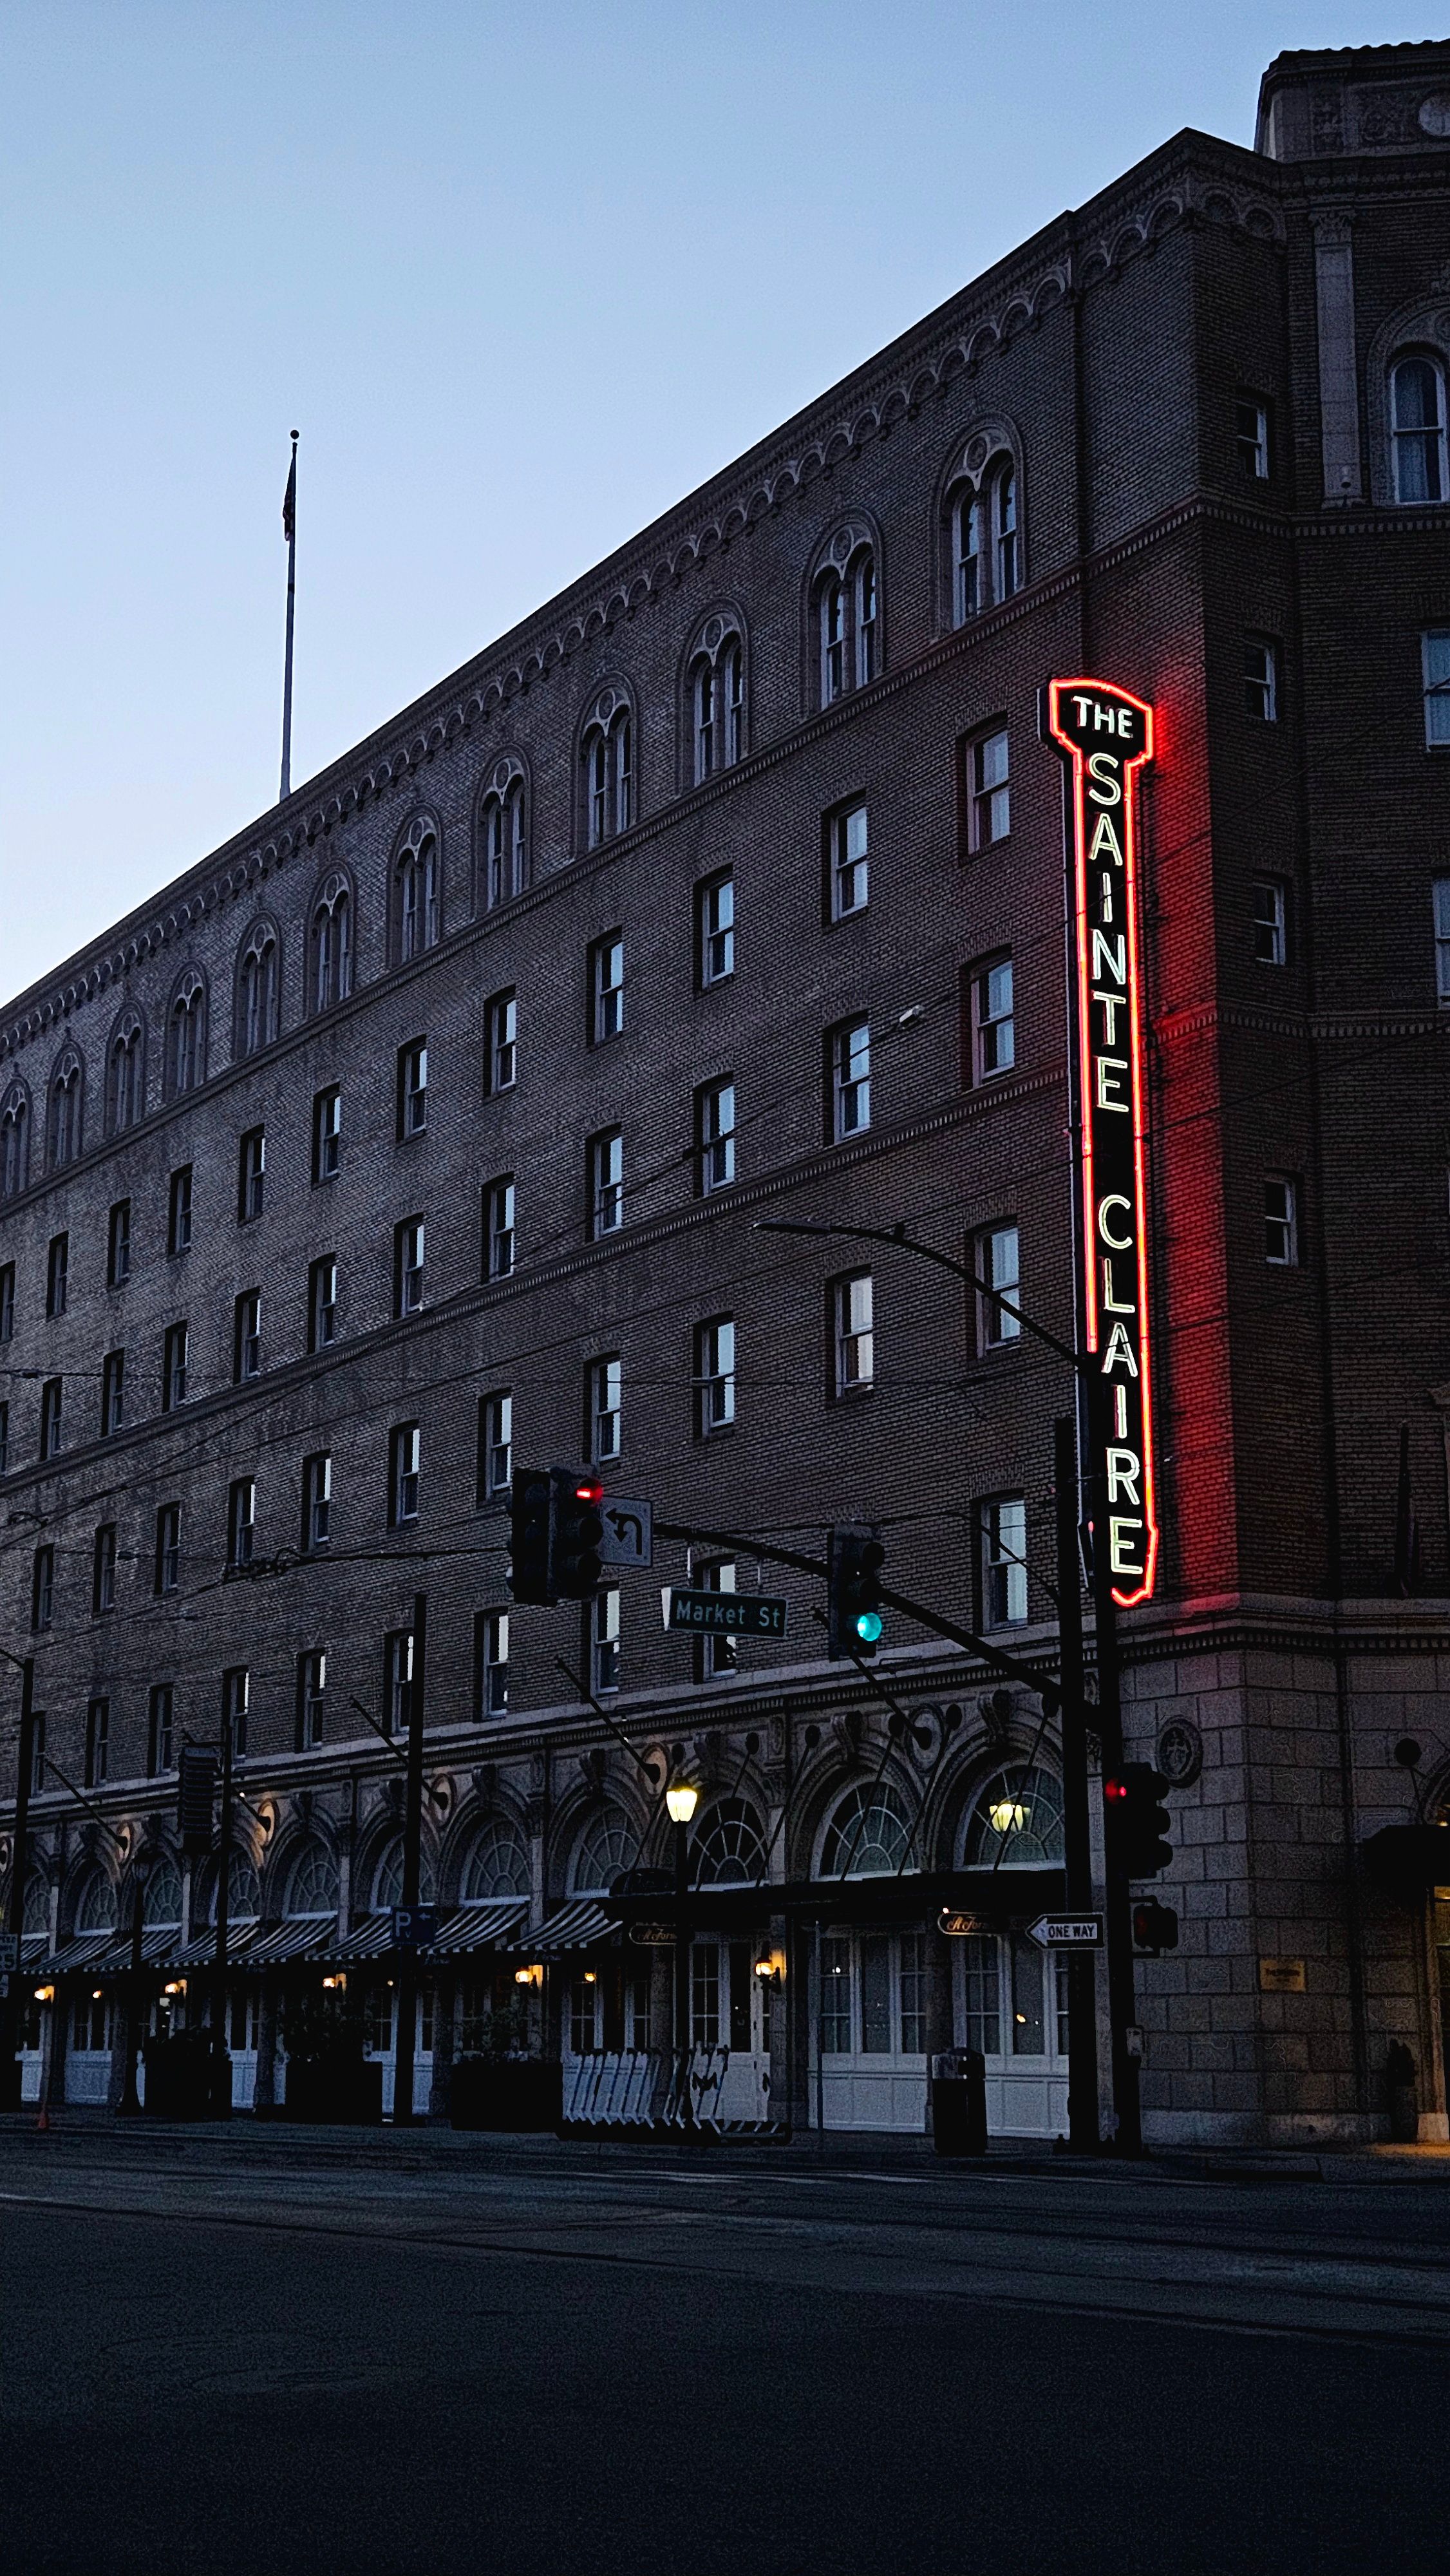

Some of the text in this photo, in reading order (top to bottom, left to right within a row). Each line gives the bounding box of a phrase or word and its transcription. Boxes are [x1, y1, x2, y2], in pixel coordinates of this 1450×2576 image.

[1071, 696, 1133, 738] THE
[1088, 752, 1129, 1113] SAINTE
[1098, 1194, 1143, 1575] CLAIRE
[676, 1599, 780, 1628] Market St
[1048, 1925, 1094, 1938] ONE WAY
